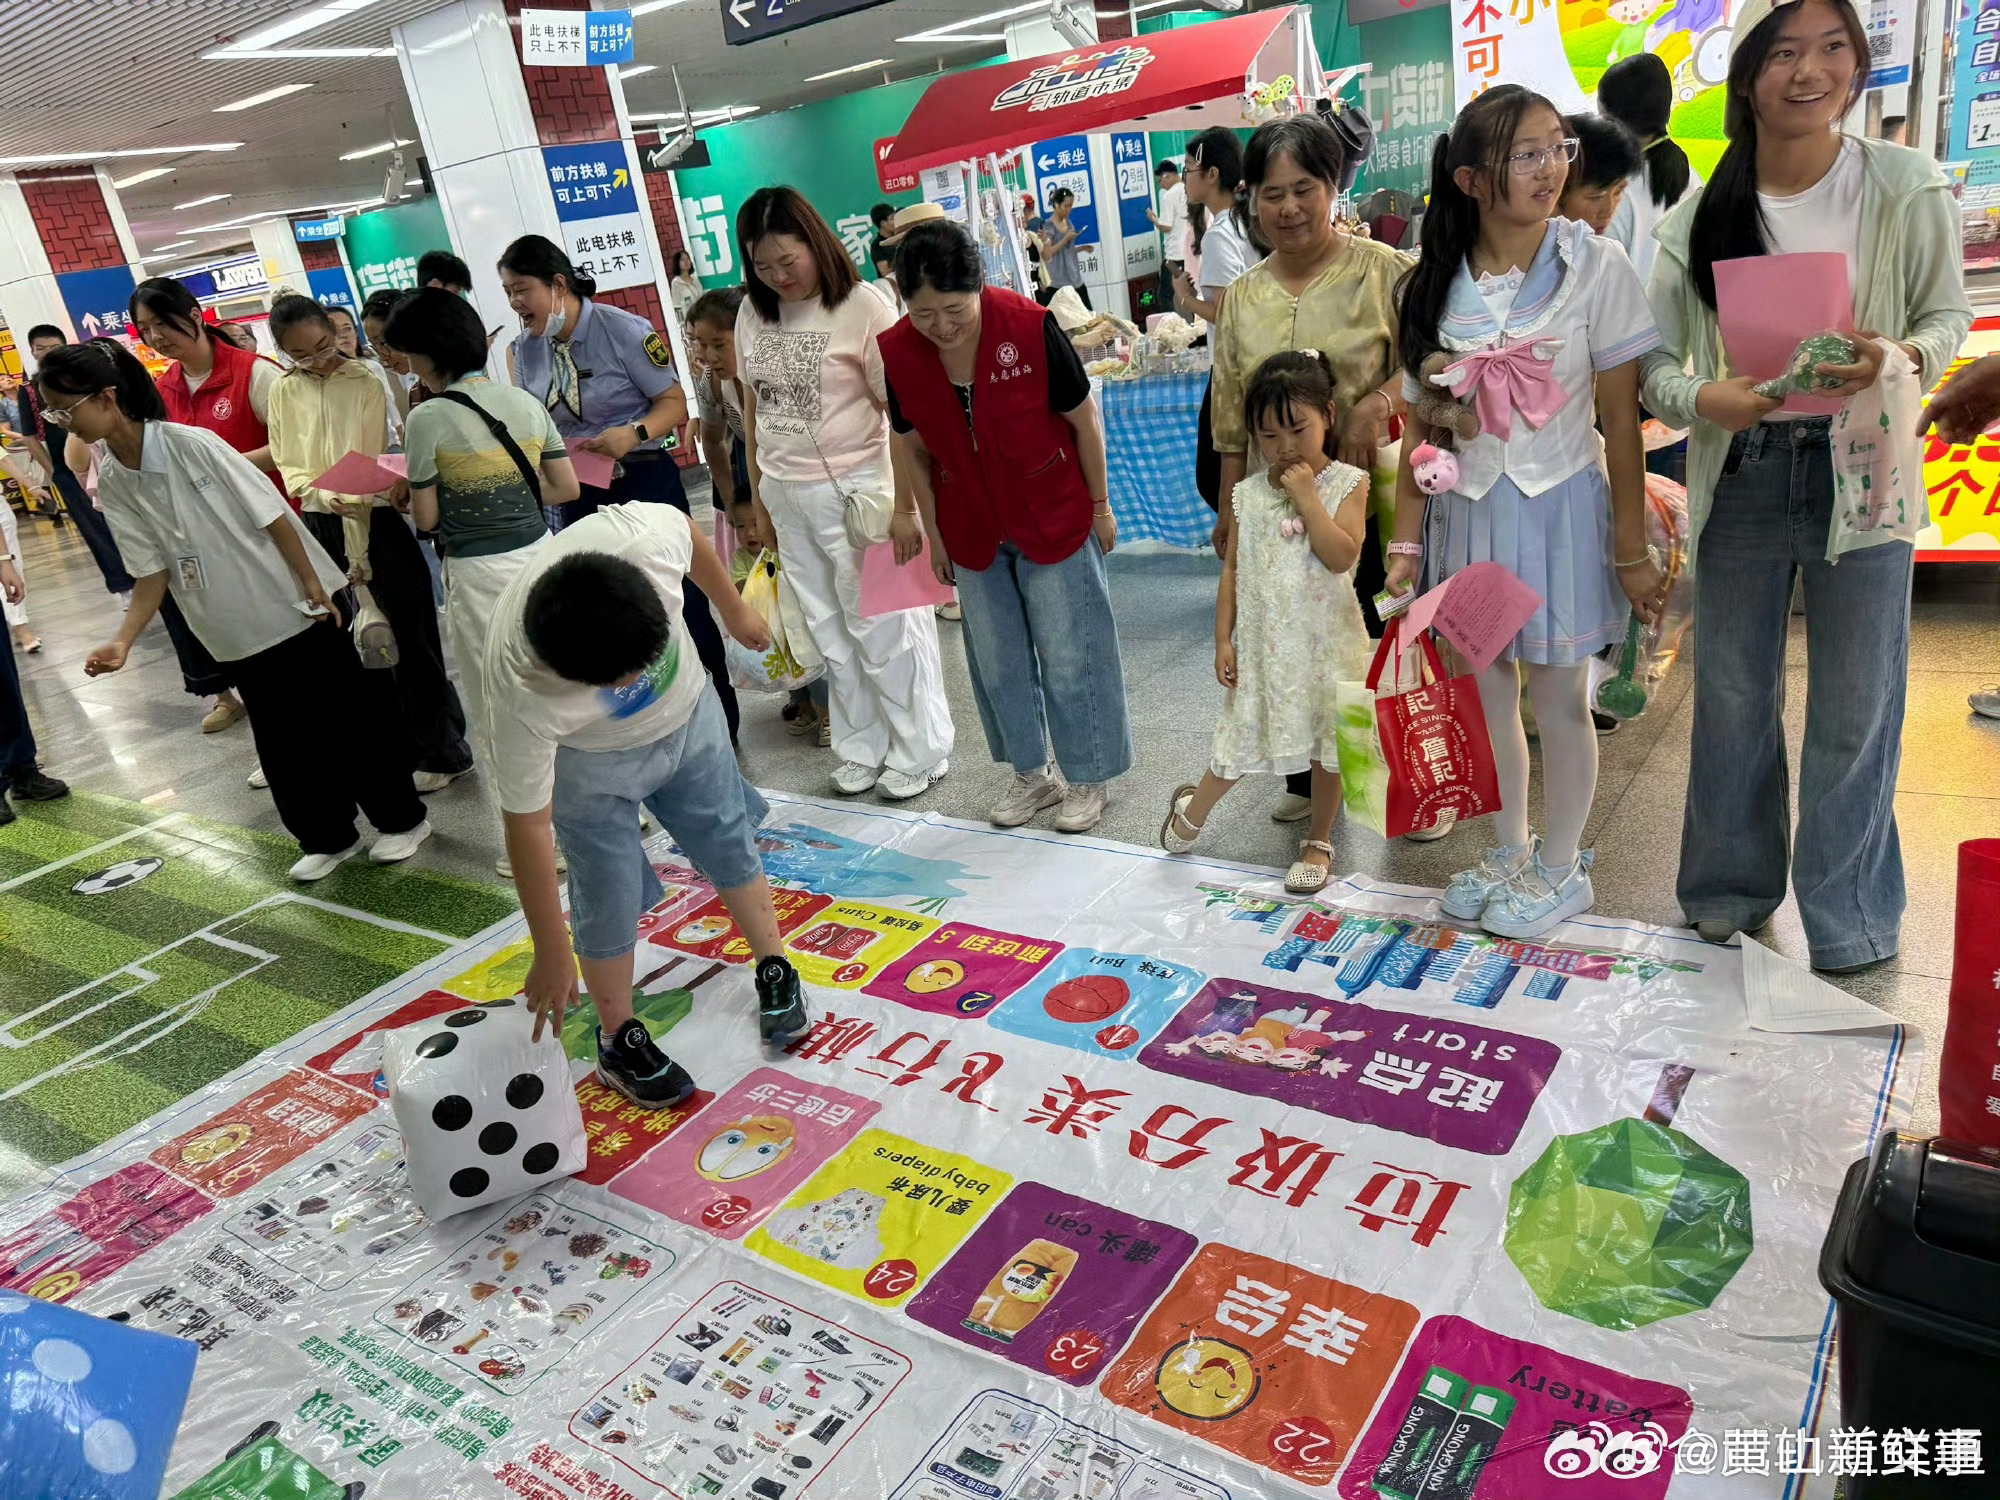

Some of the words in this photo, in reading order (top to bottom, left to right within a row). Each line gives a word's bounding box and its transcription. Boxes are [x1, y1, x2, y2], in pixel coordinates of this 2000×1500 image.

[530, 24, 580, 38] 此电扶梯
[589, 23, 624, 38] 前方扶梯
[531, 41, 580, 53] 只上不下
[590, 39, 624, 53] 可上可下
[1056, 147, 1087, 169] 乘坐
[1124, 138, 1143, 158] 乘坐
[550, 161, 608, 183] 前方扶梯
[885, 175, 915, 190] 进口零食
[1121, 167, 1145, 194] 2号线
[555, 183, 612, 204] 可上可下
[576, 230, 636, 254] 此电扶梯
[582, 253, 640, 276] 只上不下
[1127, 246, 1155, 266] 由此向前
[328, 292, 349, 304] 乘坐
[1405, 690, 1436, 716] 記
[1420, 713, 1453, 724] SINCE
[1419, 736, 1457, 786] 詹記
[1411, 789, 1443, 828] TSIMKEE
[1445, 785, 1470, 794] SINCE
[836, 905, 877, 924] Cans
[878, 915, 930, 933] 易拉罐
[938, 929, 957, 945] 5
[837, 965, 859, 982] 3
[1088, 954, 1127, 970] Ball
[968, 991, 995, 1011] 2
[1392, 1022, 1519, 1063] start
[1358, 1050, 1505, 1113] 起点
[746, 1083, 858, 1125] 后退三步
[784, 1010, 1473, 1248] 垃圾分类飞行棋
[875, 1145, 938, 1178] diapers
[938, 1163, 991, 1195] baby
[889, 1175, 976, 1216] 婴儿尿布
[710, 1199, 743, 1224] 25
[1046, 1213, 1092, 1237] can
[1098, 1235, 1164, 1264] 罐头
[870, 1263, 914, 1293] 24
[136, 1284, 235, 1353] 其他垃圾
[1215, 1274, 1369, 1367] 幸会
[1049, 1341, 1092, 1366] 23
[1508, 1364, 1656, 1431] battery
[293, 1386, 411, 1468] 厨余垃圾
[1272, 1422, 1331, 1465] 22
[1380, 1405, 1423, 1479] KINGKONG
[1426, 1422, 1470, 1492] KINGKONG
